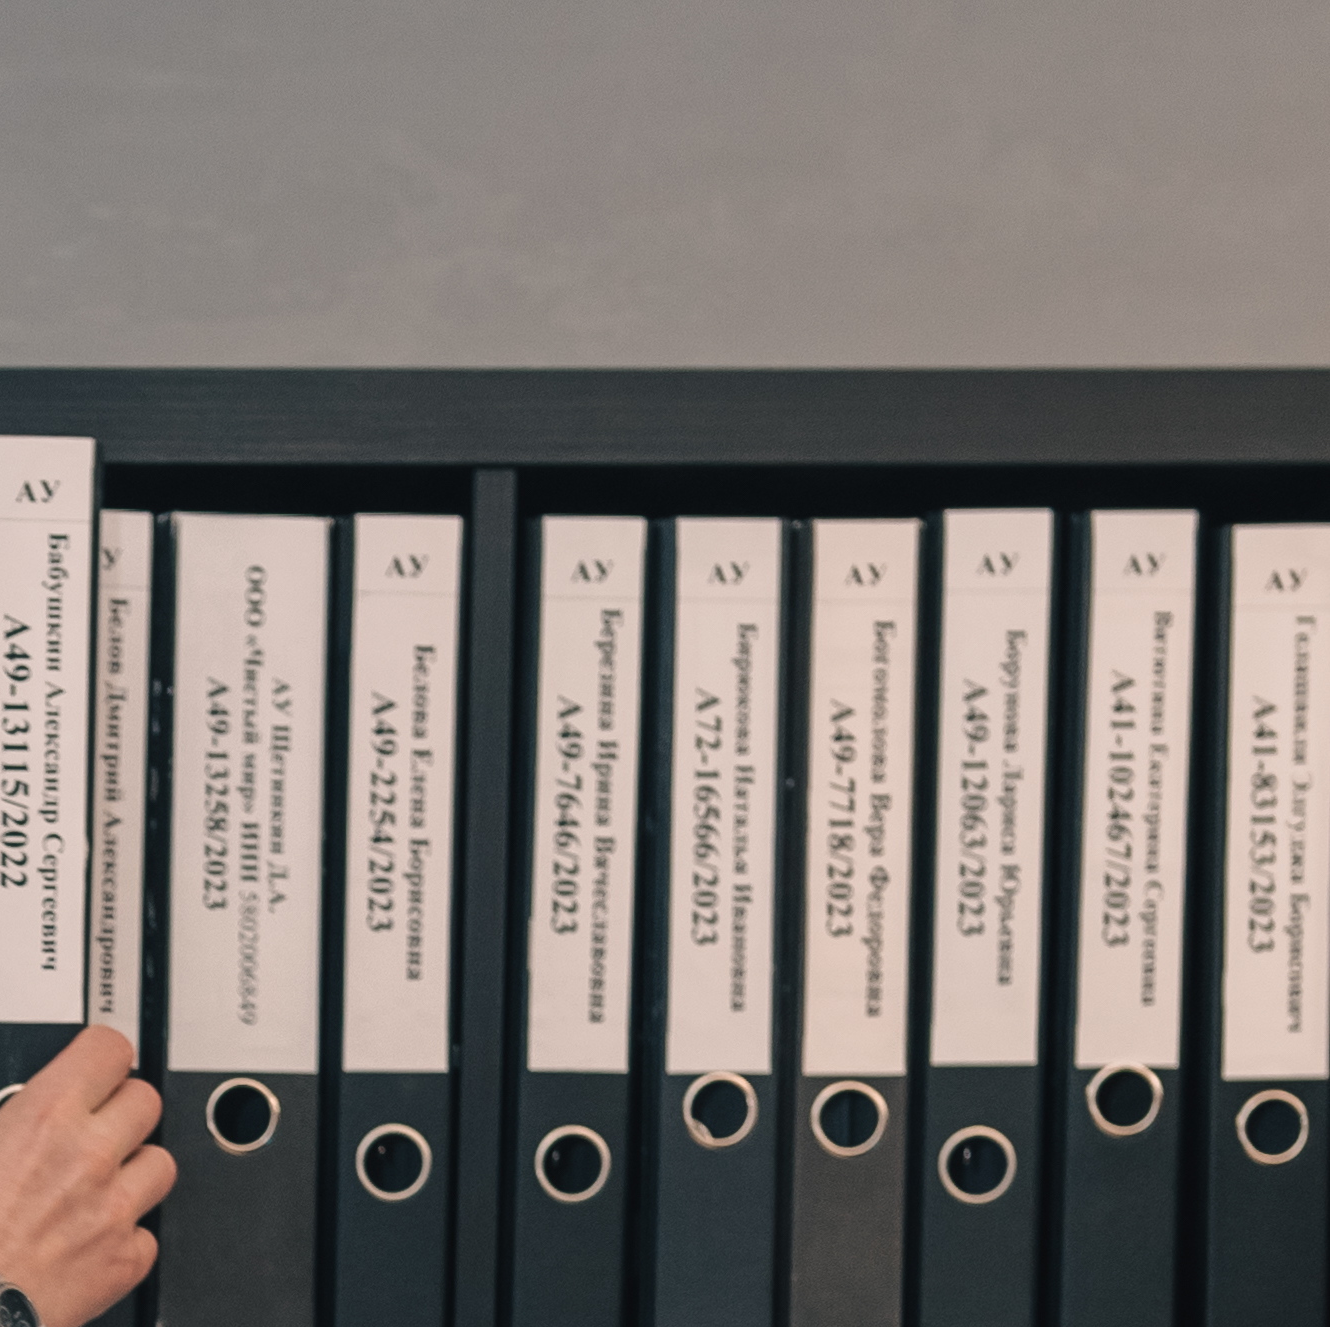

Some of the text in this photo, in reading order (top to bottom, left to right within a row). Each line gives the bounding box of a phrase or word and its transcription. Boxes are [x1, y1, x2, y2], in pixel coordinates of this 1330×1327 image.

[14, 479, 62, 506] АУ
[386, 553, 430, 579] АУ
[569, 559, 613, 586] АУ
[706, 561, 750, 586] АУ
[843, 562, 887, 588] АУ
[976, 551, 1020, 577] АУ
[272, 679, 293, 712] АУ
[0, 614, 33, 889] А49-13115/2022
[35, 534, 70, 971] Бабушкин Александр Сергеевич
[90, 597, 130, 1014] Белов Дмитрий Александрович
[365, 692, 400, 933] А49-2254/2023
[399, 644, 437, 982] Белова Елена Борисовна
